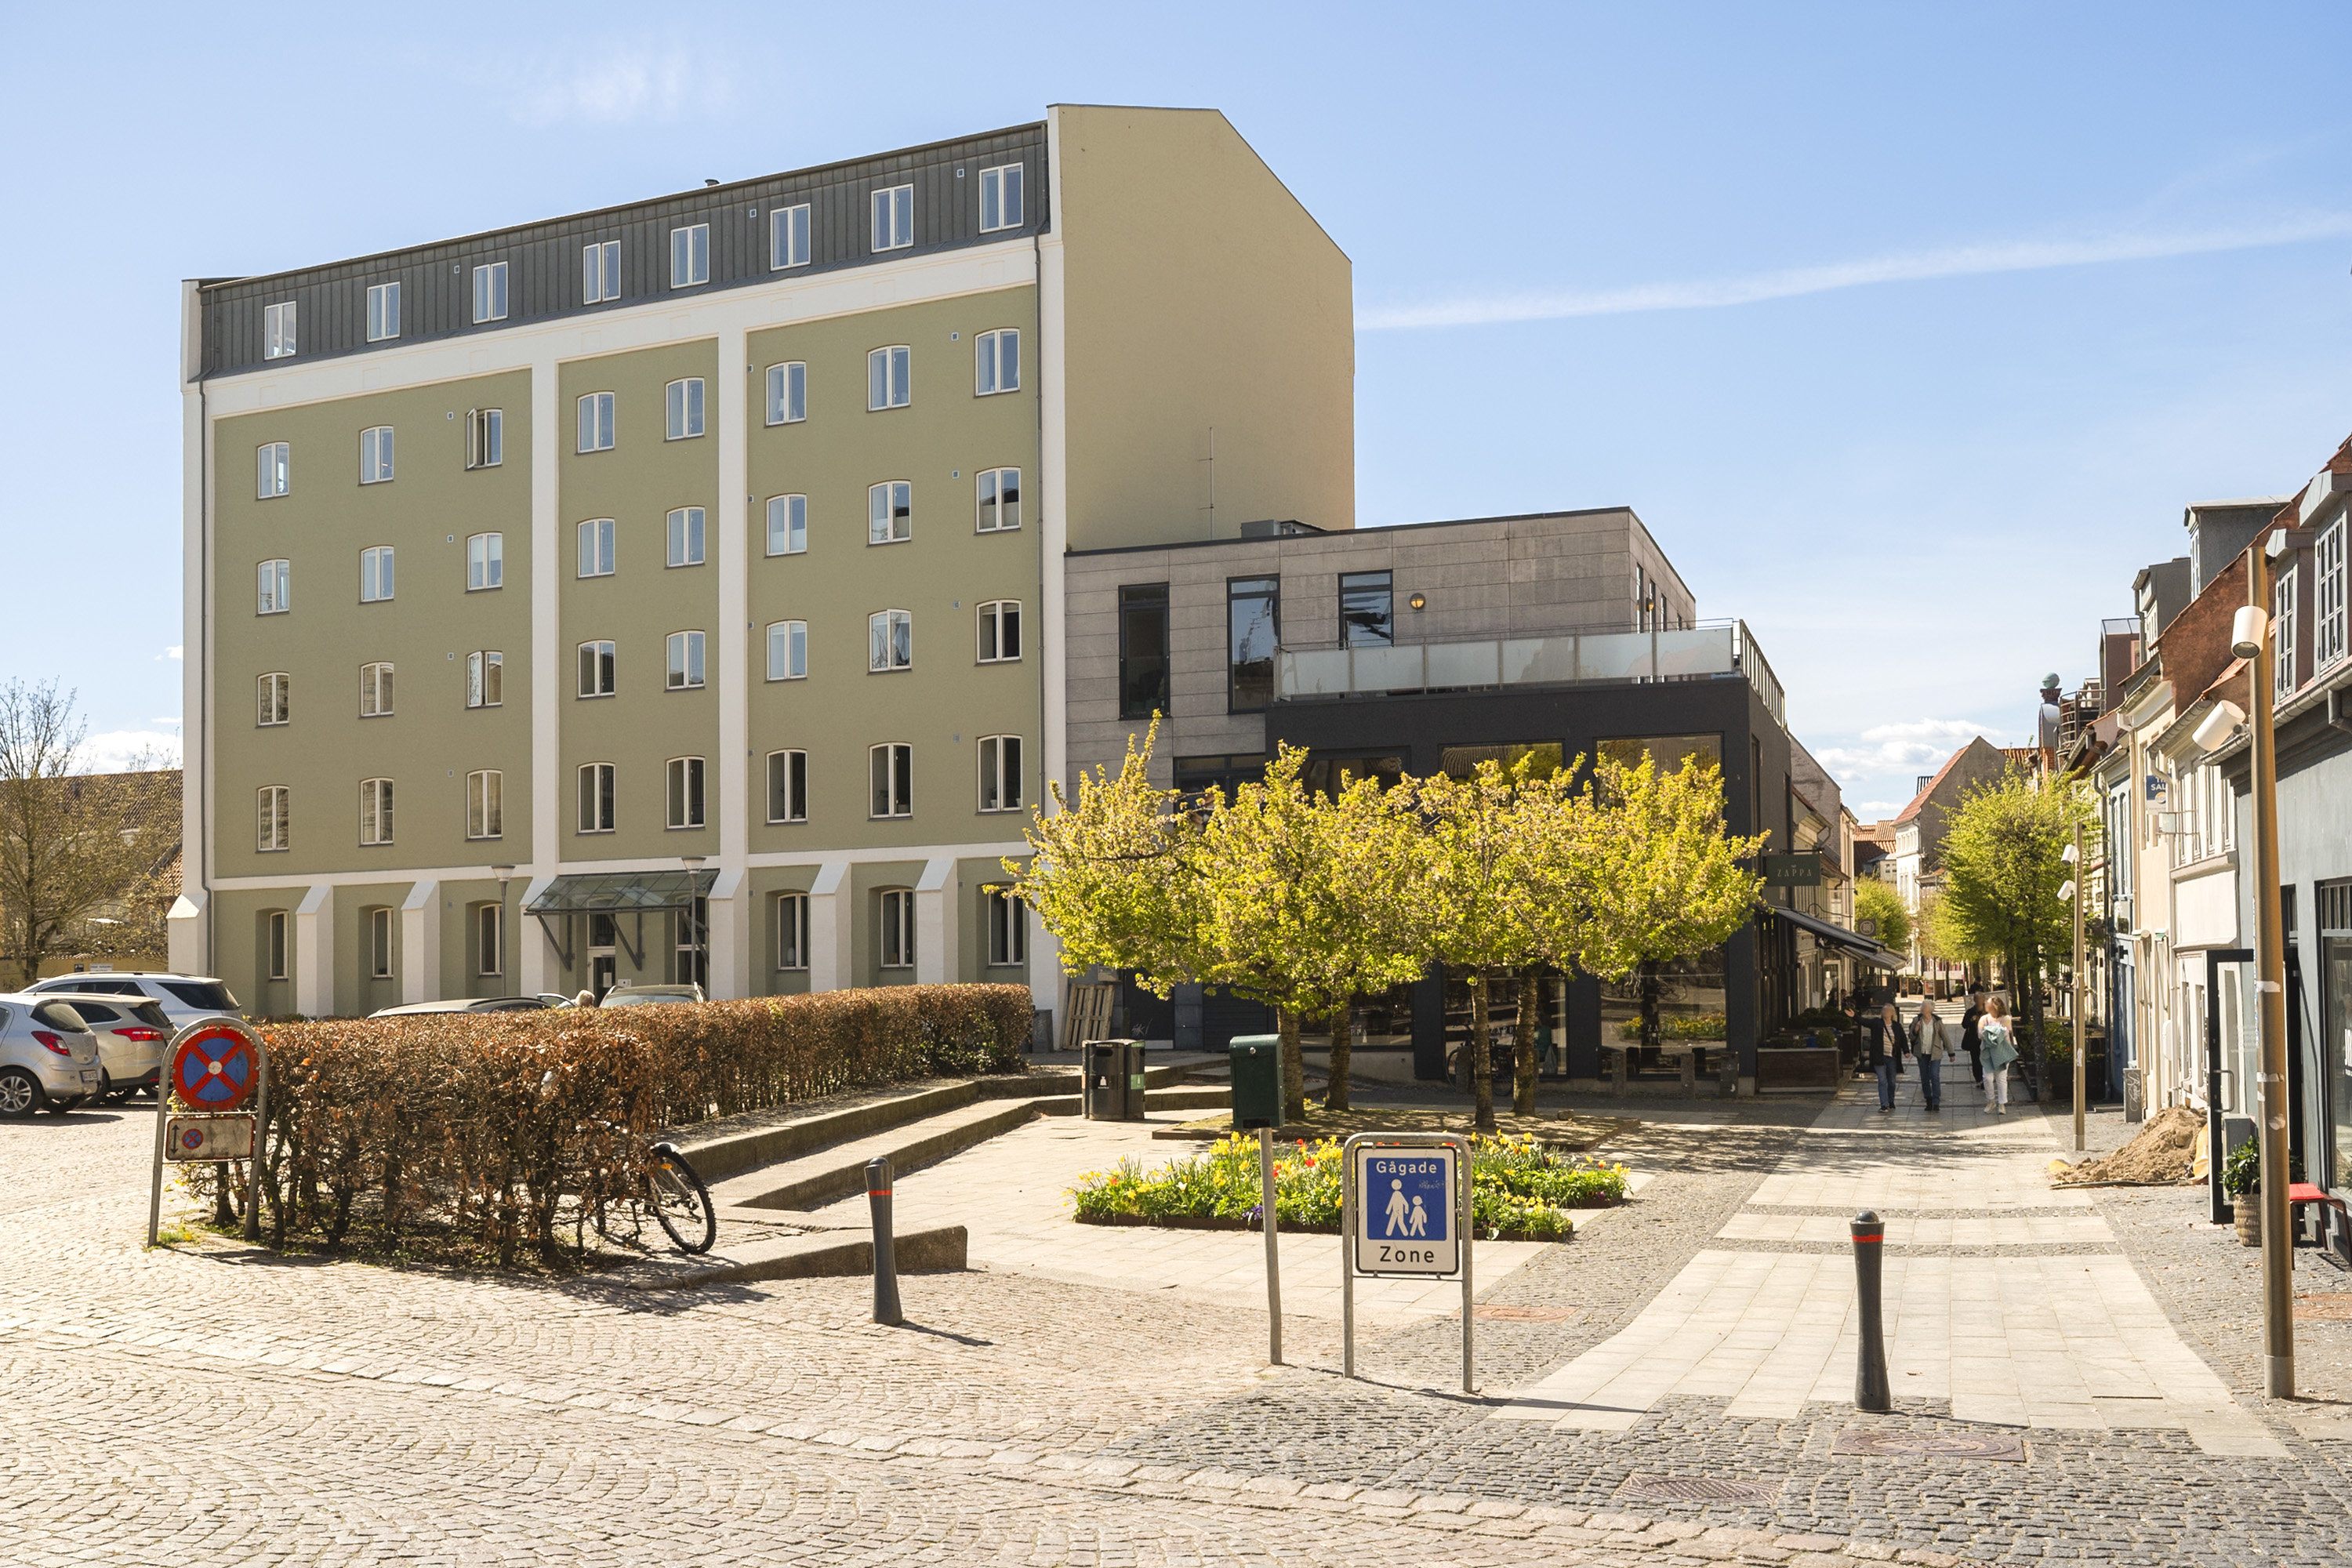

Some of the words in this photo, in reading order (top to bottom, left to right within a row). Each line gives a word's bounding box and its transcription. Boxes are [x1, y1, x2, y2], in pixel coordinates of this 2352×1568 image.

[1777, 869, 1812, 877] ZAPPA
[1376, 1160, 1437, 1176] Gågade
[1380, 1246, 1435, 1263] Zone
